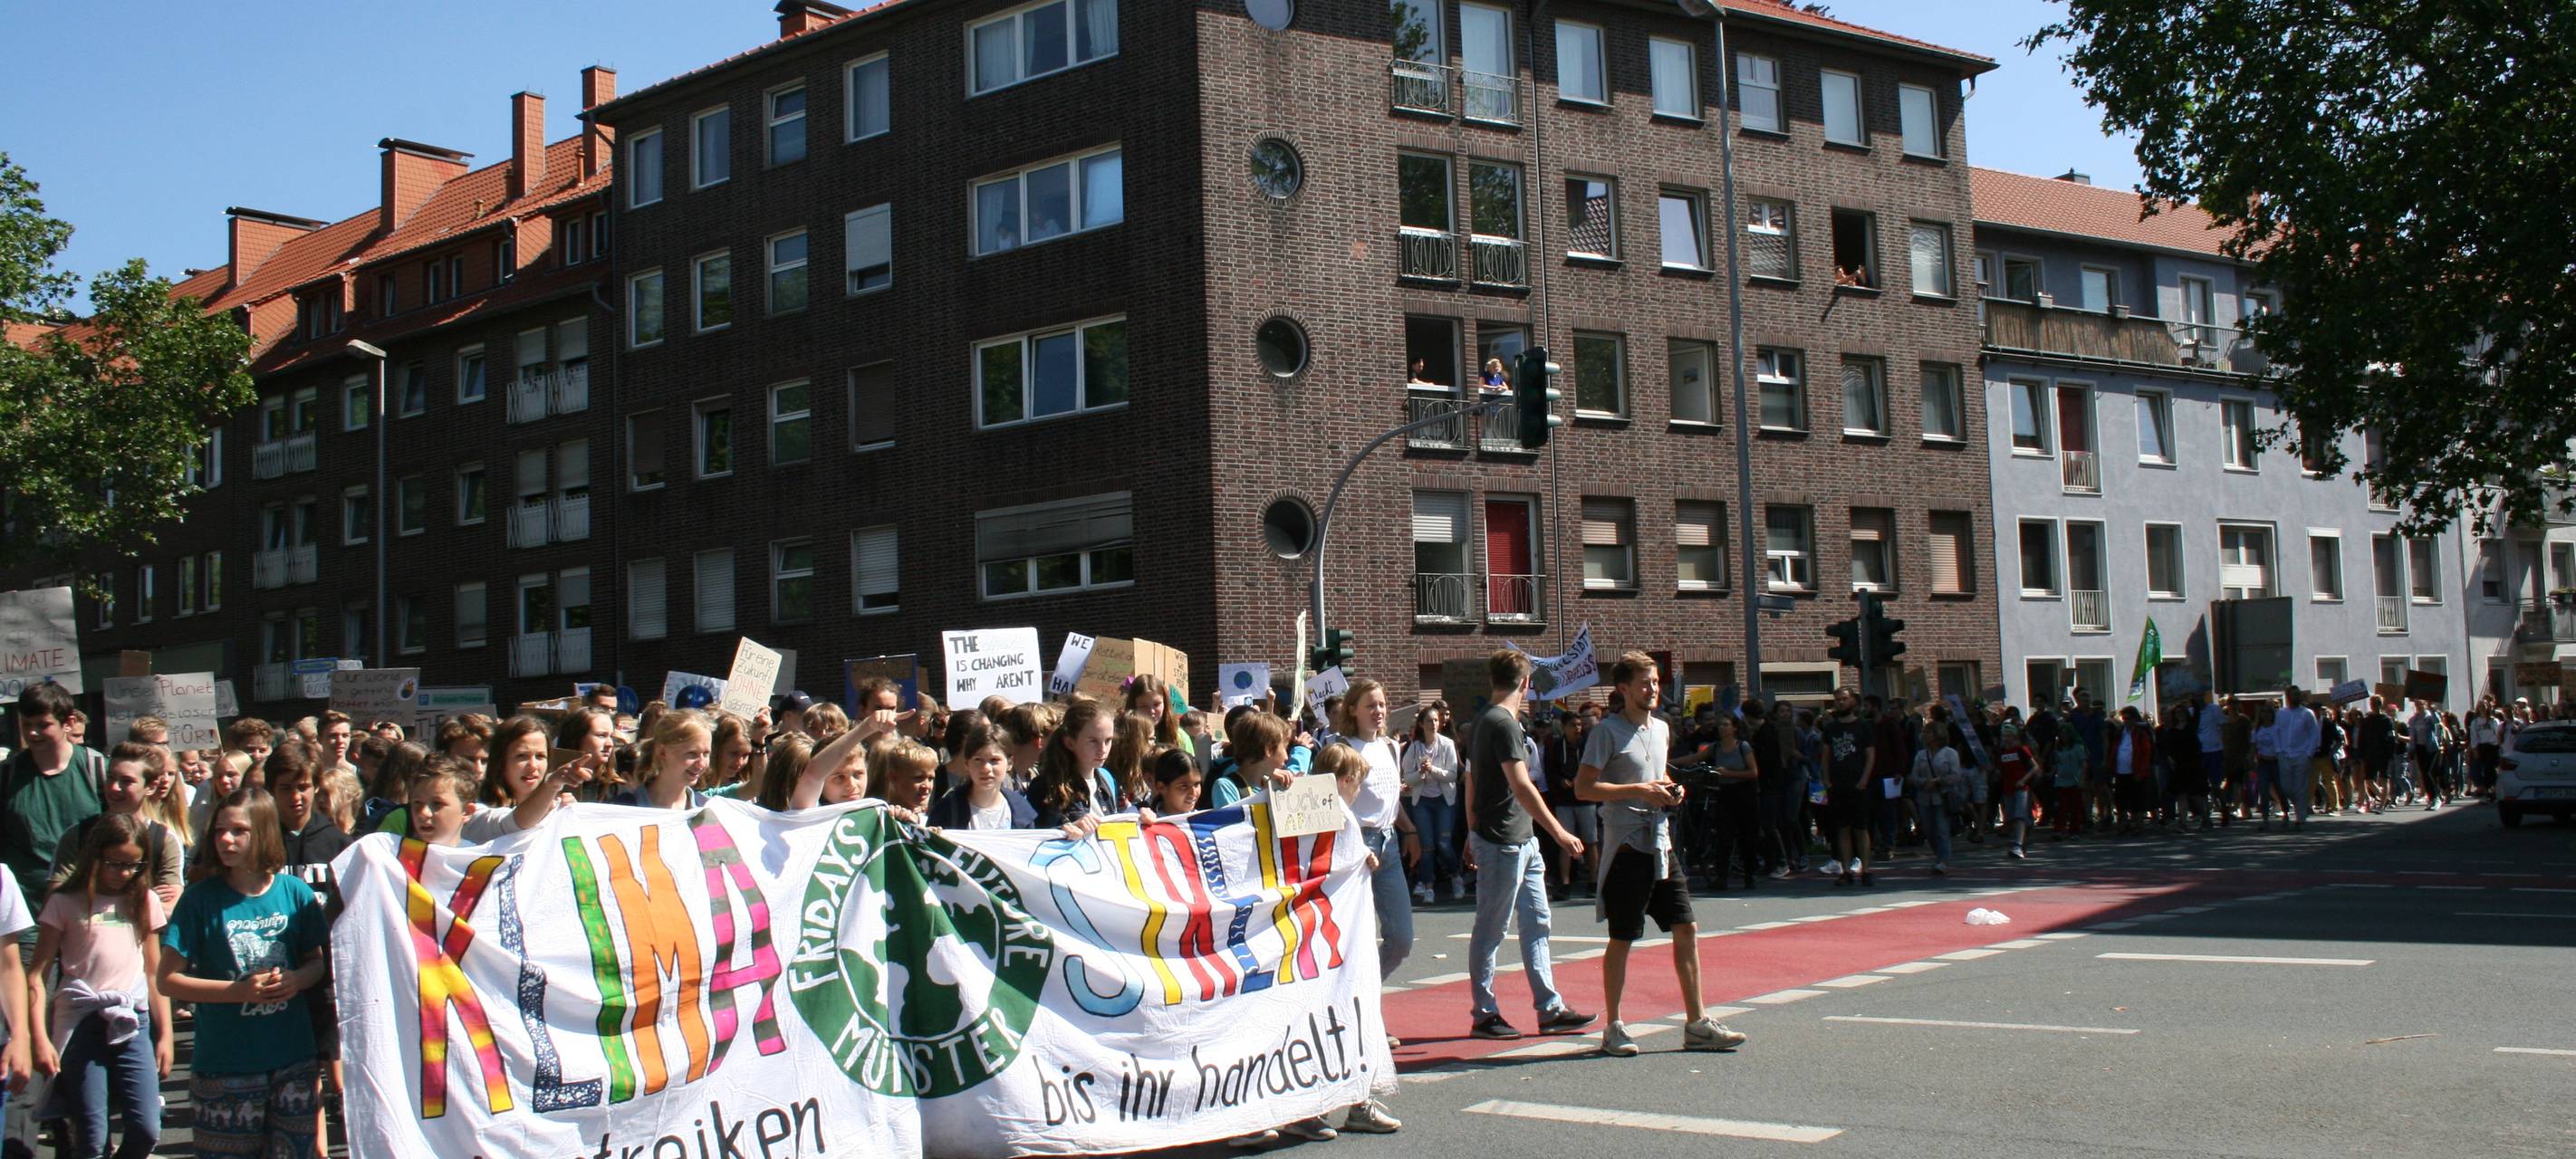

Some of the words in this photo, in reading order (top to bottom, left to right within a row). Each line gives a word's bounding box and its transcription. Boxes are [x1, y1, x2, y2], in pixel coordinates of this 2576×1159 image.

[949, 636, 980, 654] THE
[1071, 635, 1090, 649] WE
[0, 648, 65, 673] IMATE
[956, 659, 968, 673] IS
[971, 653, 1024, 671] CHANGING
[159, 679, 214, 697] Planet
[733, 675, 765, 702] OHNE
[956, 677, 977, 693] WHY
[995, 670, 1034, 689] ARENT
[1322, 793, 1334, 810] of
[789, 818, 870, 992] FRIDAYS
[398, 808, 786, 1120] KLIMA
[831, 1006, 1024, 1096] MÜNSTER
[1033, 1054, 1096, 1126] bis
[1120, 1052, 1175, 1122] ihr
[1191, 996, 1368, 1112] handelt!
